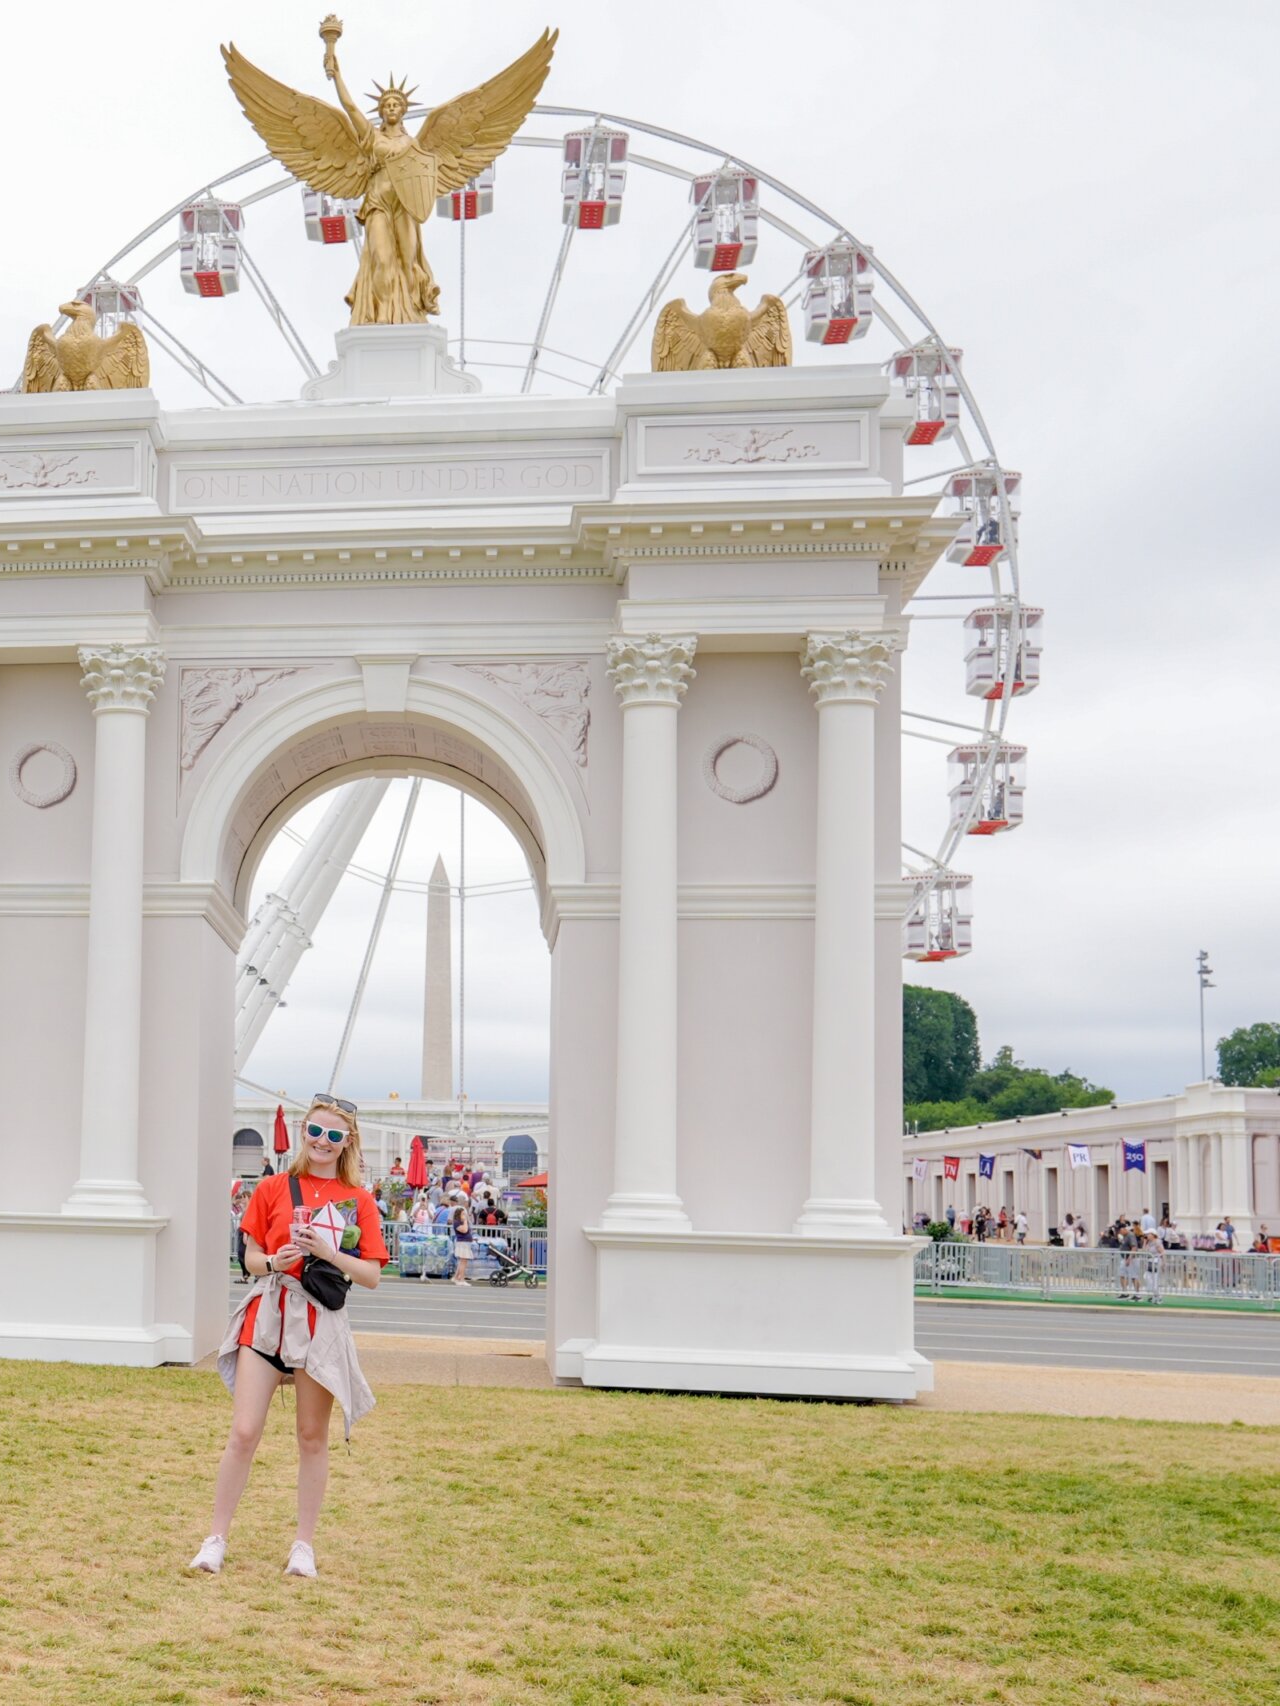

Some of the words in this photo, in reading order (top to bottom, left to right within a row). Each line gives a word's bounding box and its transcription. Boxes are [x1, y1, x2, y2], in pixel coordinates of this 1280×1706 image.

[184, 475, 249, 499] ONE
[261, 470, 384, 497] NATION
[395, 466, 511, 493] UNDER
[520, 464, 595, 489] GOD
[1072, 1152, 1087, 1163] PR
[1126, 1152, 1144, 1163] 250
[945, 1163, 957, 1176] TN
[980, 1161, 991, 1175] LA
